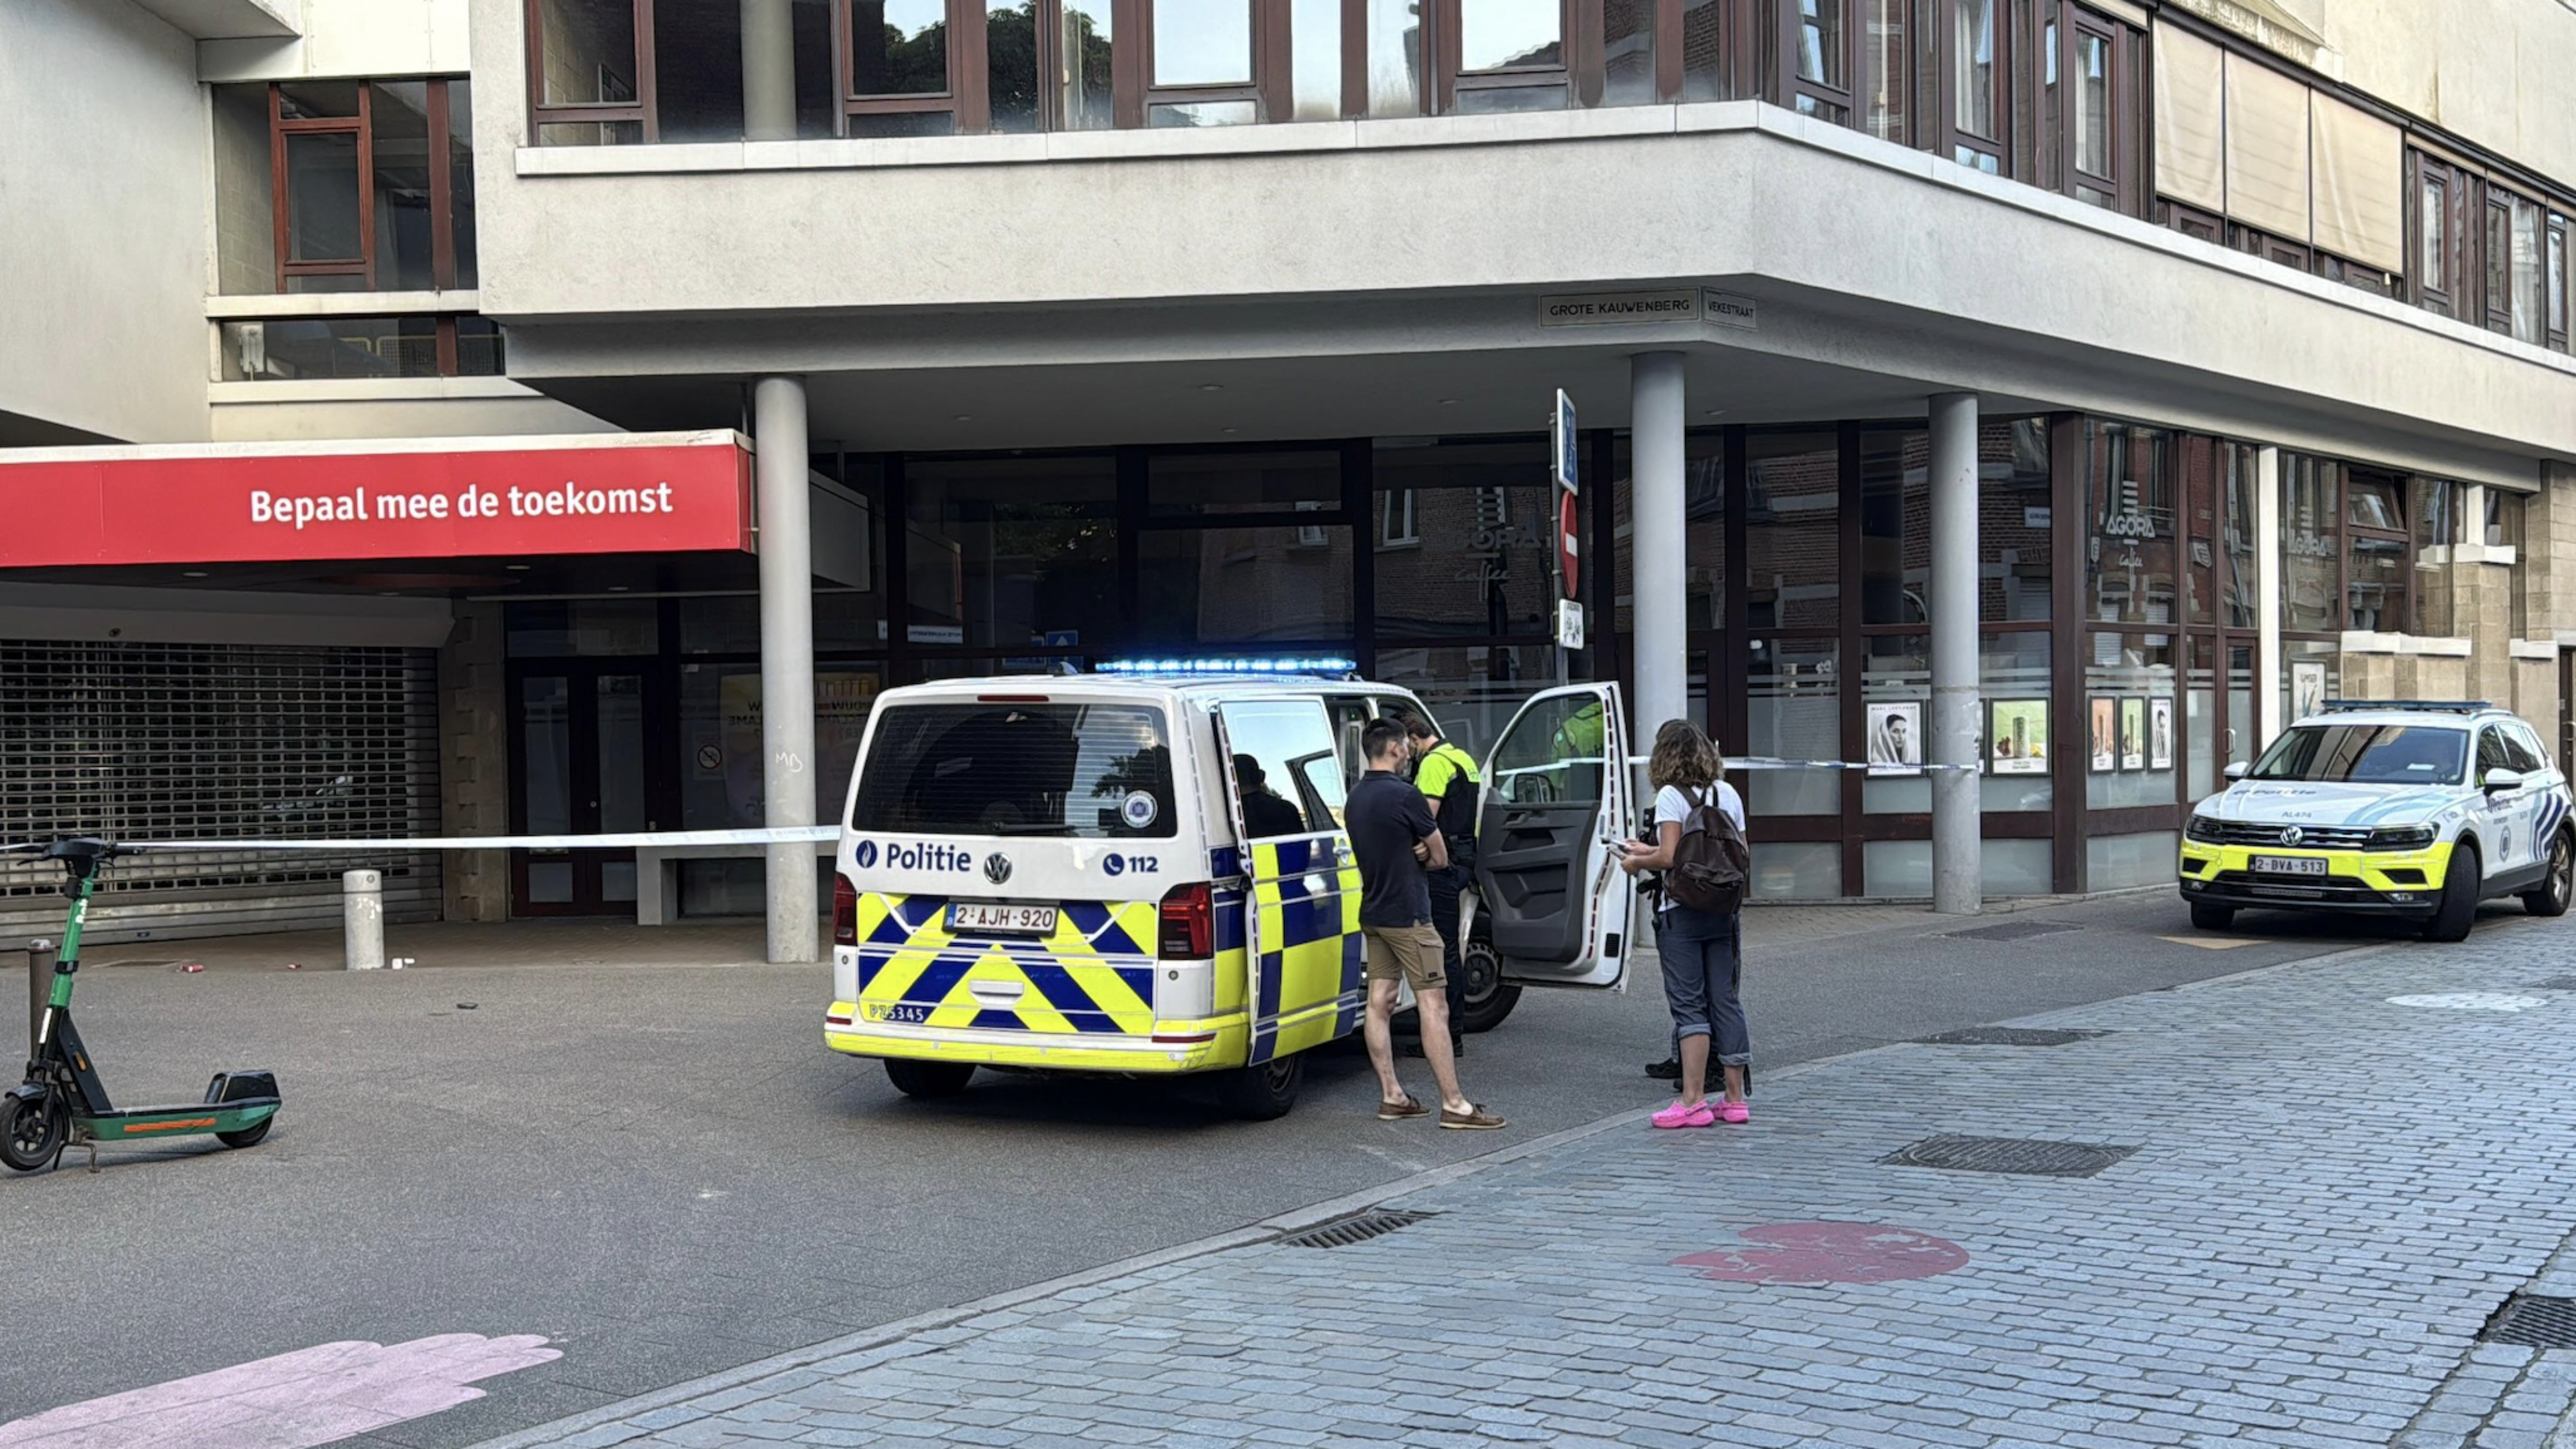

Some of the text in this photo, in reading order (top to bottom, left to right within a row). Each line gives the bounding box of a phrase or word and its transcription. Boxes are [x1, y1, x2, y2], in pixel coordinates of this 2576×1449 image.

[1550, 299, 1690, 316] GROTE KAUWENBERG
[1708, 300, 1754, 319] VEKESTRAAT
[250, 481, 674, 529] Bepaal mee de toekomst
[2106, 513, 2156, 538] AGORA
[886, 843, 971, 872] Politie
[1129, 857, 1159, 873] 112
[956, 906, 1053, 928] 2-AJH-920
